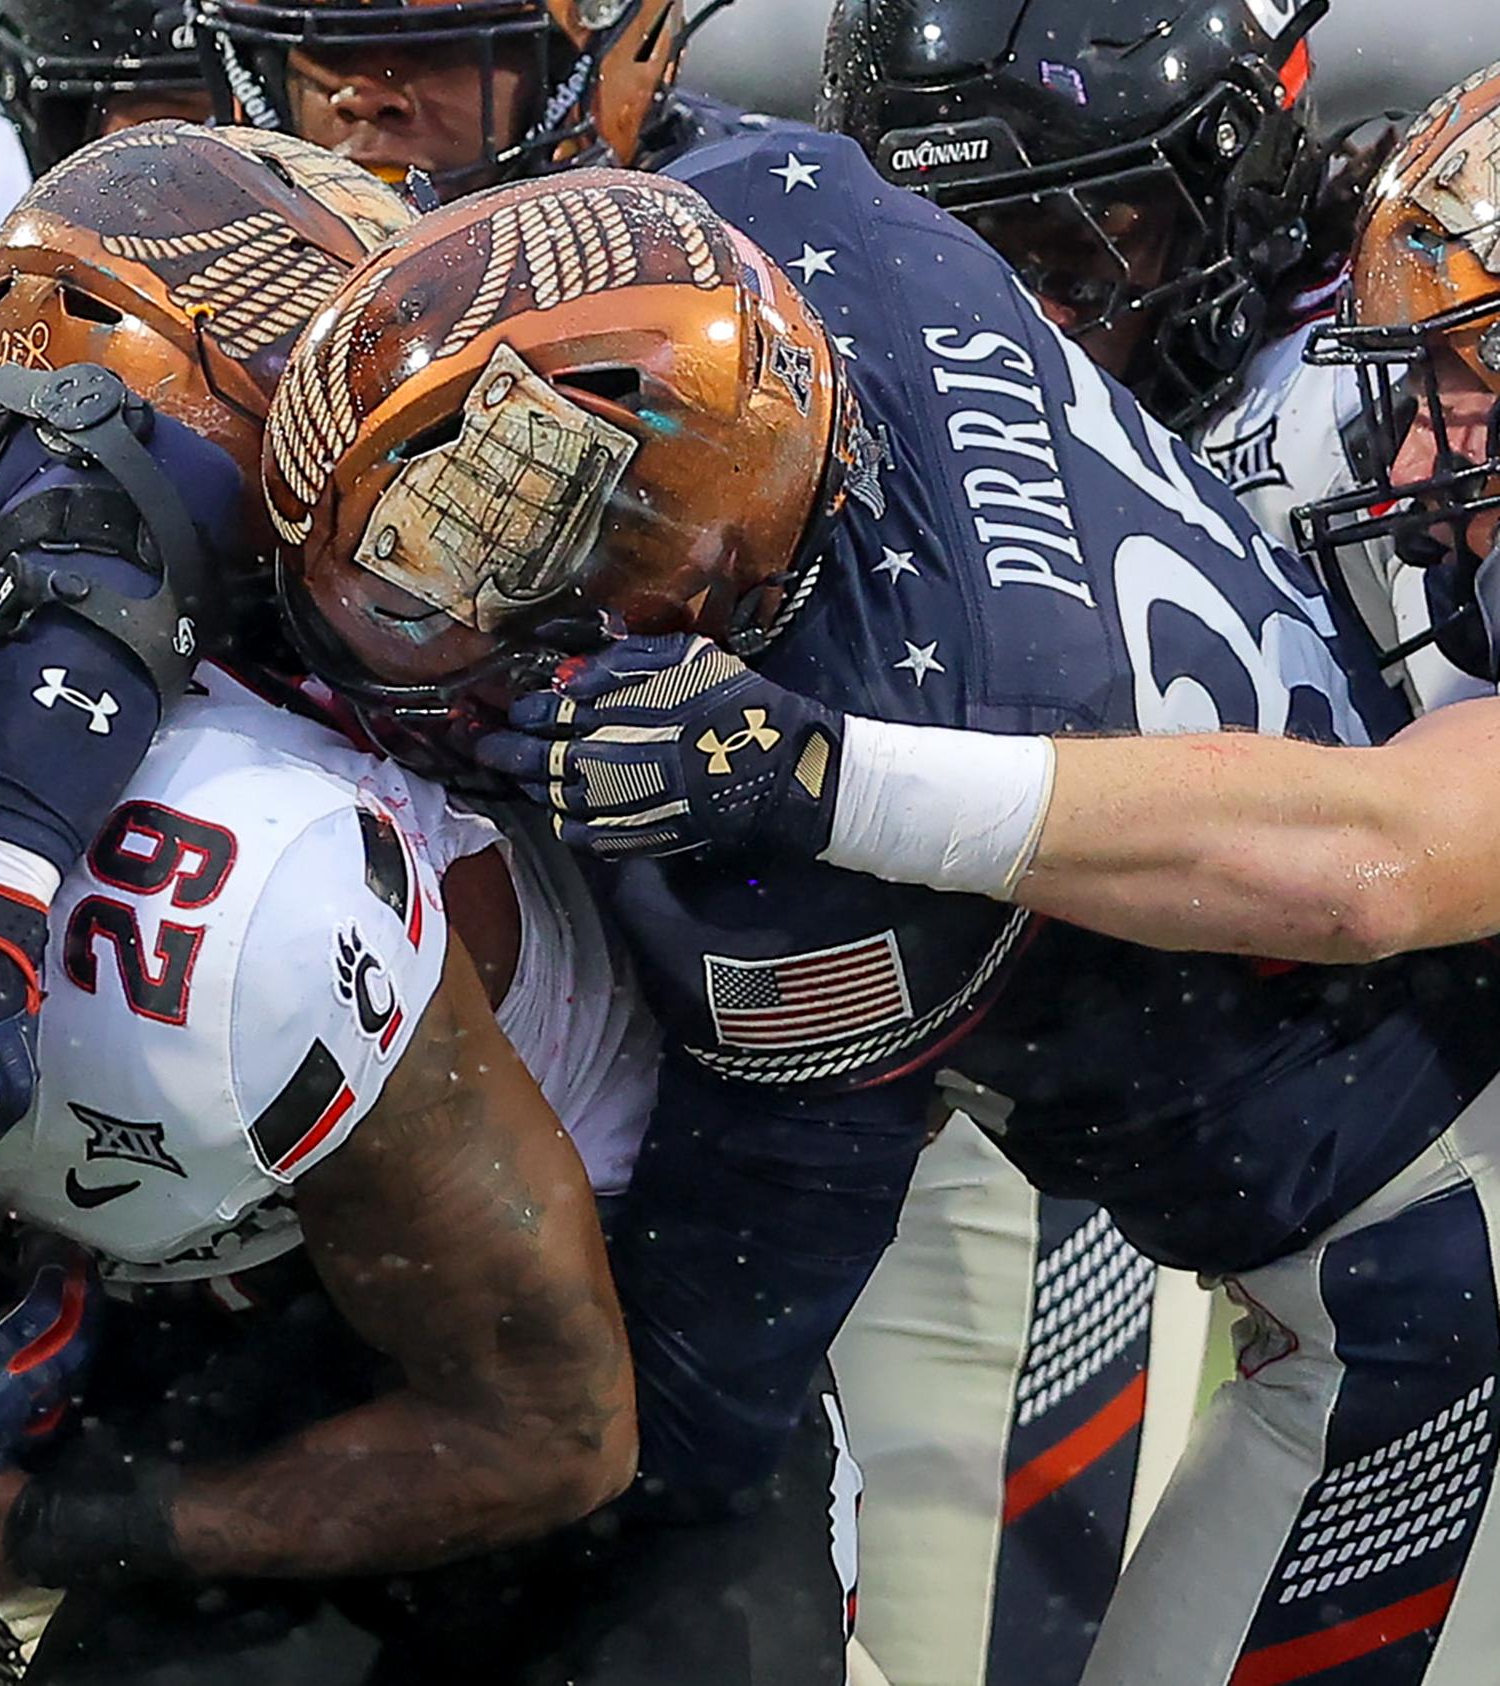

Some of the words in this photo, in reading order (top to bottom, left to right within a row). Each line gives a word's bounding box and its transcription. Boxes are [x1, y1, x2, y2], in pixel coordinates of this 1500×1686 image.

[890, 138, 990, 171] CINCINNATI
[921, 326, 1098, 609] PIRRIS
[63, 799, 239, 1028] 29
